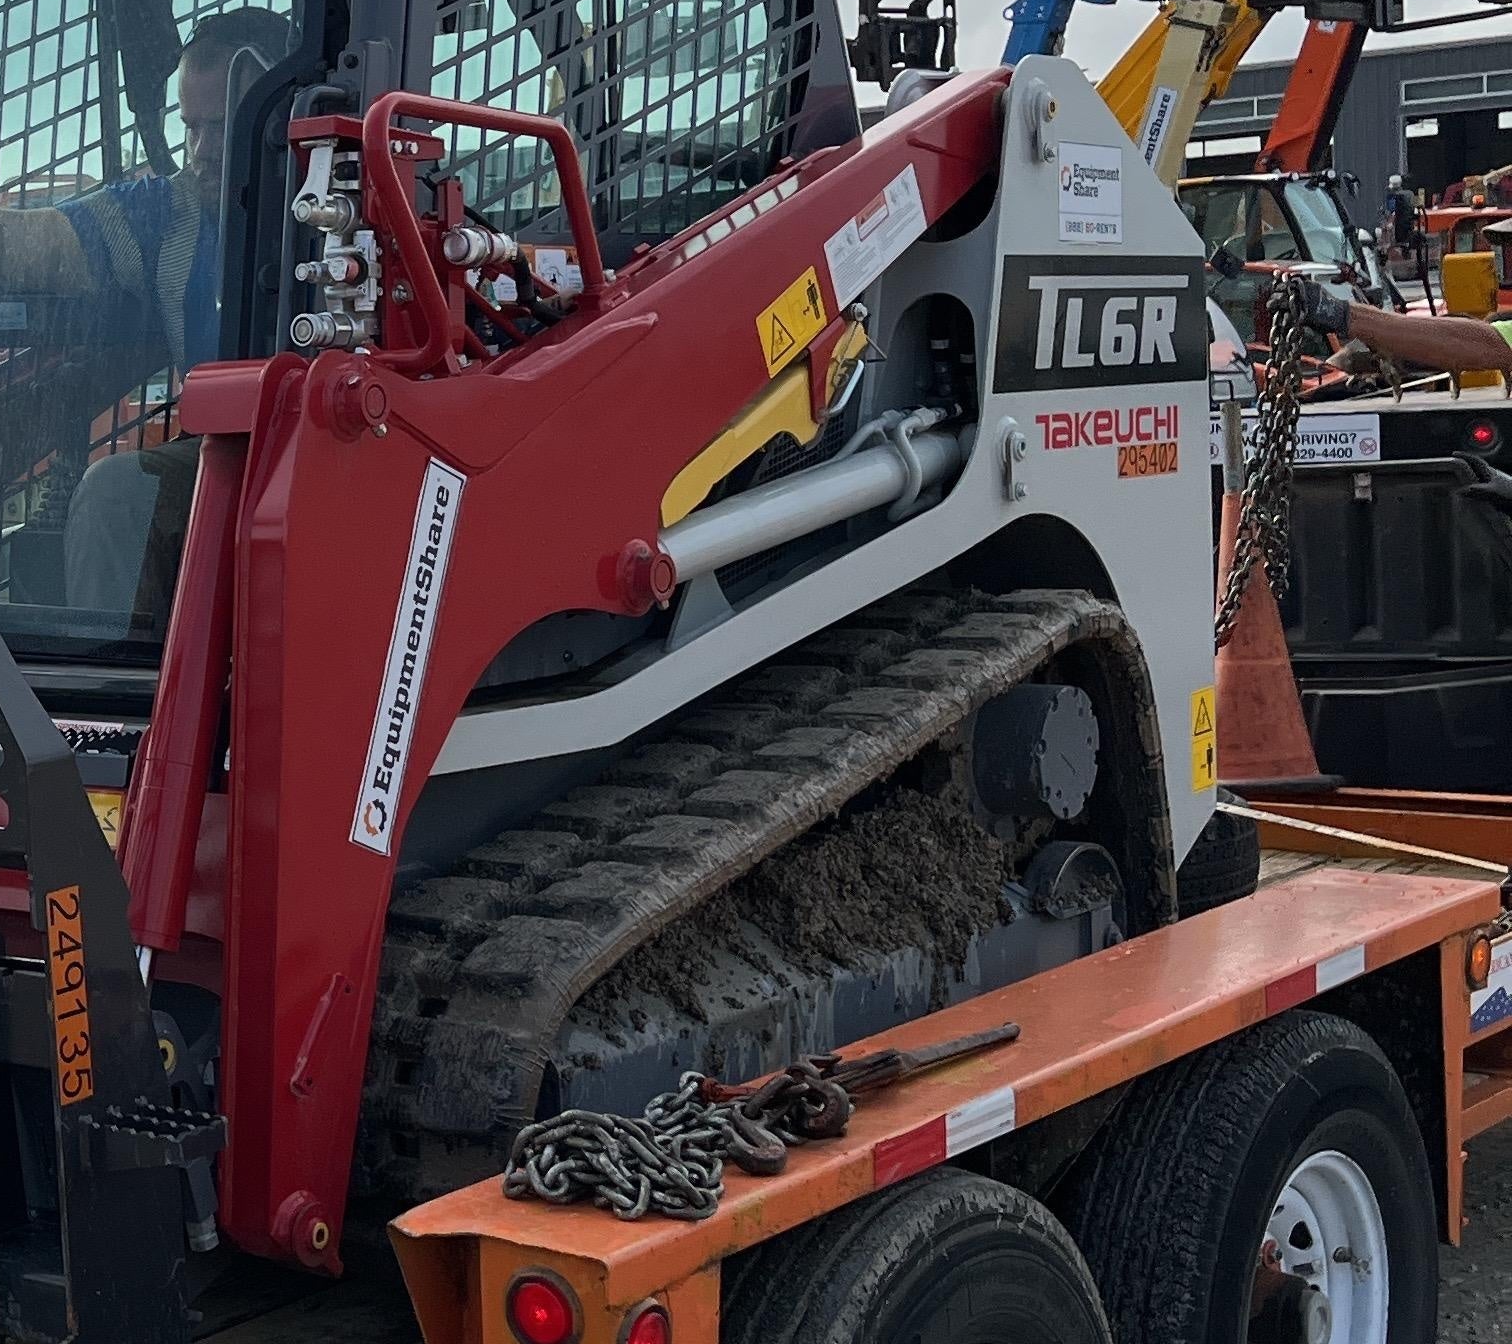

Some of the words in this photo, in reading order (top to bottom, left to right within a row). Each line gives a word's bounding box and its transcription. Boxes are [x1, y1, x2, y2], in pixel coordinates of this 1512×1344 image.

[1073, 163, 1120, 183] Equipment
[1073, 181, 1099, 198] Share
[1028, 275, 1189, 370] TL6R
[1118, 443, 1177, 478] 295402
[373, 484, 450, 795] EquipmentShare
[49, 893, 93, 1098] 249135
